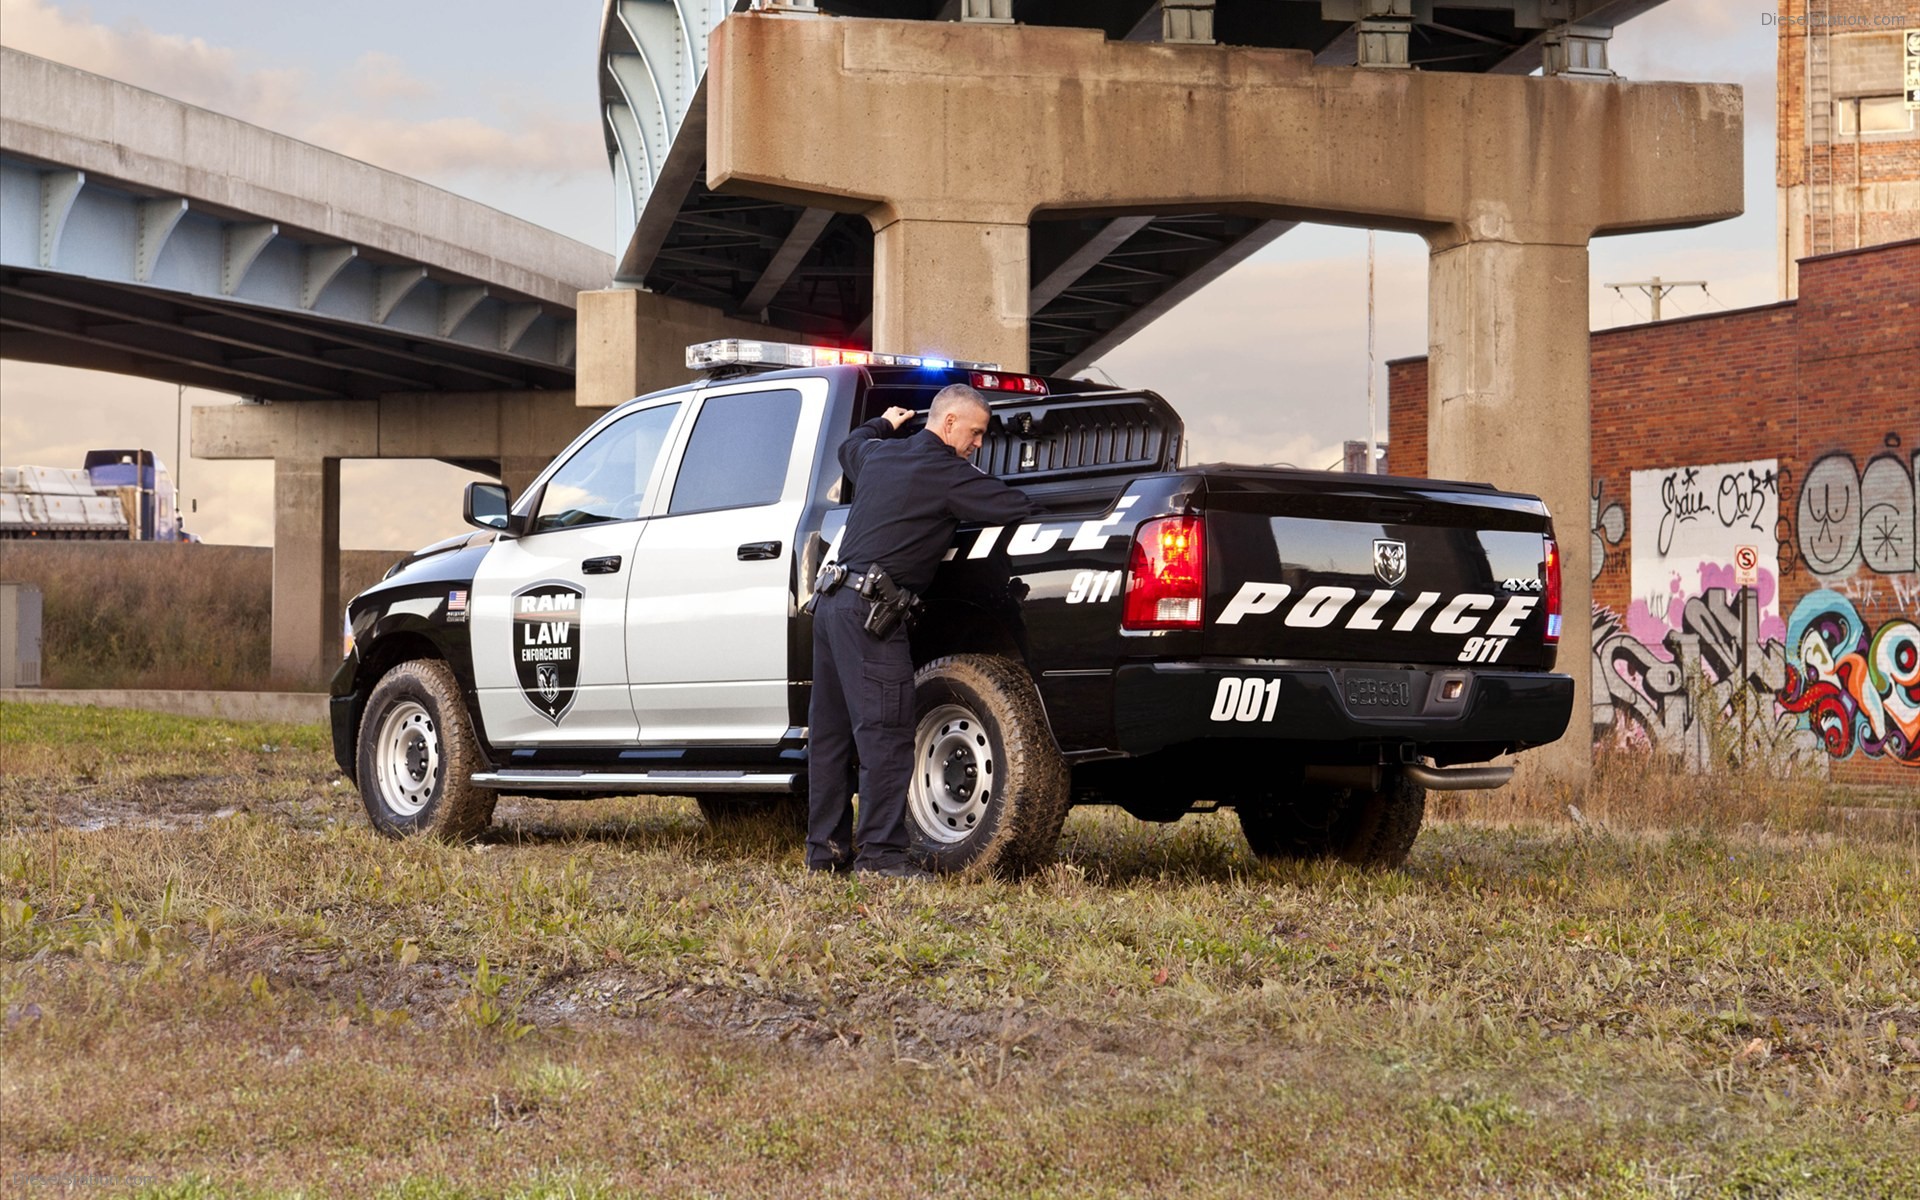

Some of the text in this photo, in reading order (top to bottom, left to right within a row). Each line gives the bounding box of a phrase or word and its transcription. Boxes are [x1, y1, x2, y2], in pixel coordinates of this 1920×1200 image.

[1907, 60, 1920, 76] F
[1065, 570, 1122, 604] 911
[521, 593, 576, 613] RAM
[1215, 581, 1540, 637] POLICE
[524, 621, 570, 645] LAW
[522, 646, 572, 662] ENFORCEMENT
[1457, 636, 1508, 663] 911
[1210, 676, 1281, 722] 001
